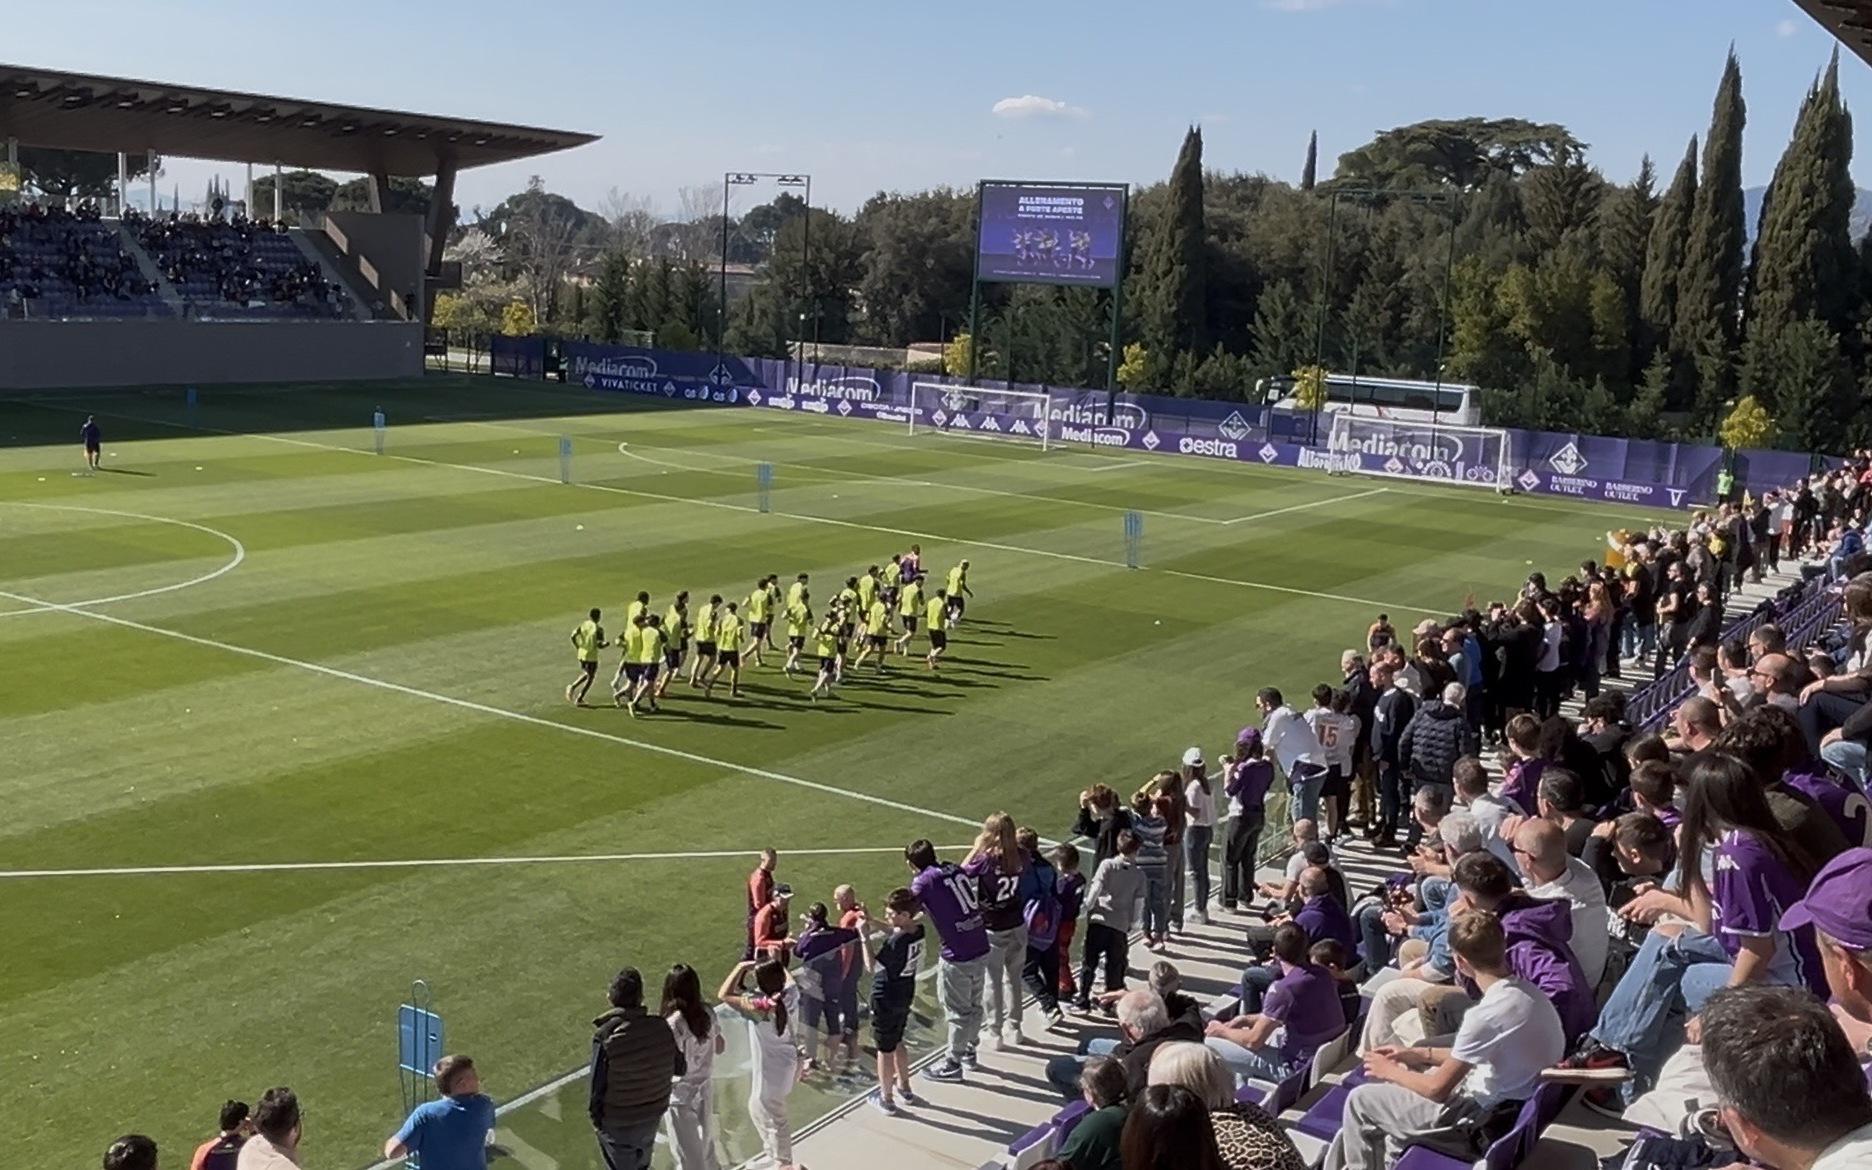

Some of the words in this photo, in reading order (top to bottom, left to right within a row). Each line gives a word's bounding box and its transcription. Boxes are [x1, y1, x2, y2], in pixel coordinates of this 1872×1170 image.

[575, 355, 652, 378] Mediacom
[601, 377, 658, 392] VIVATICKET
[786, 376, 874, 401] Mediacom
[1550, 483, 1585, 495] OUTLET
[1604, 489, 1640, 501] OUTLET
[943, 873, 979, 915] 10
